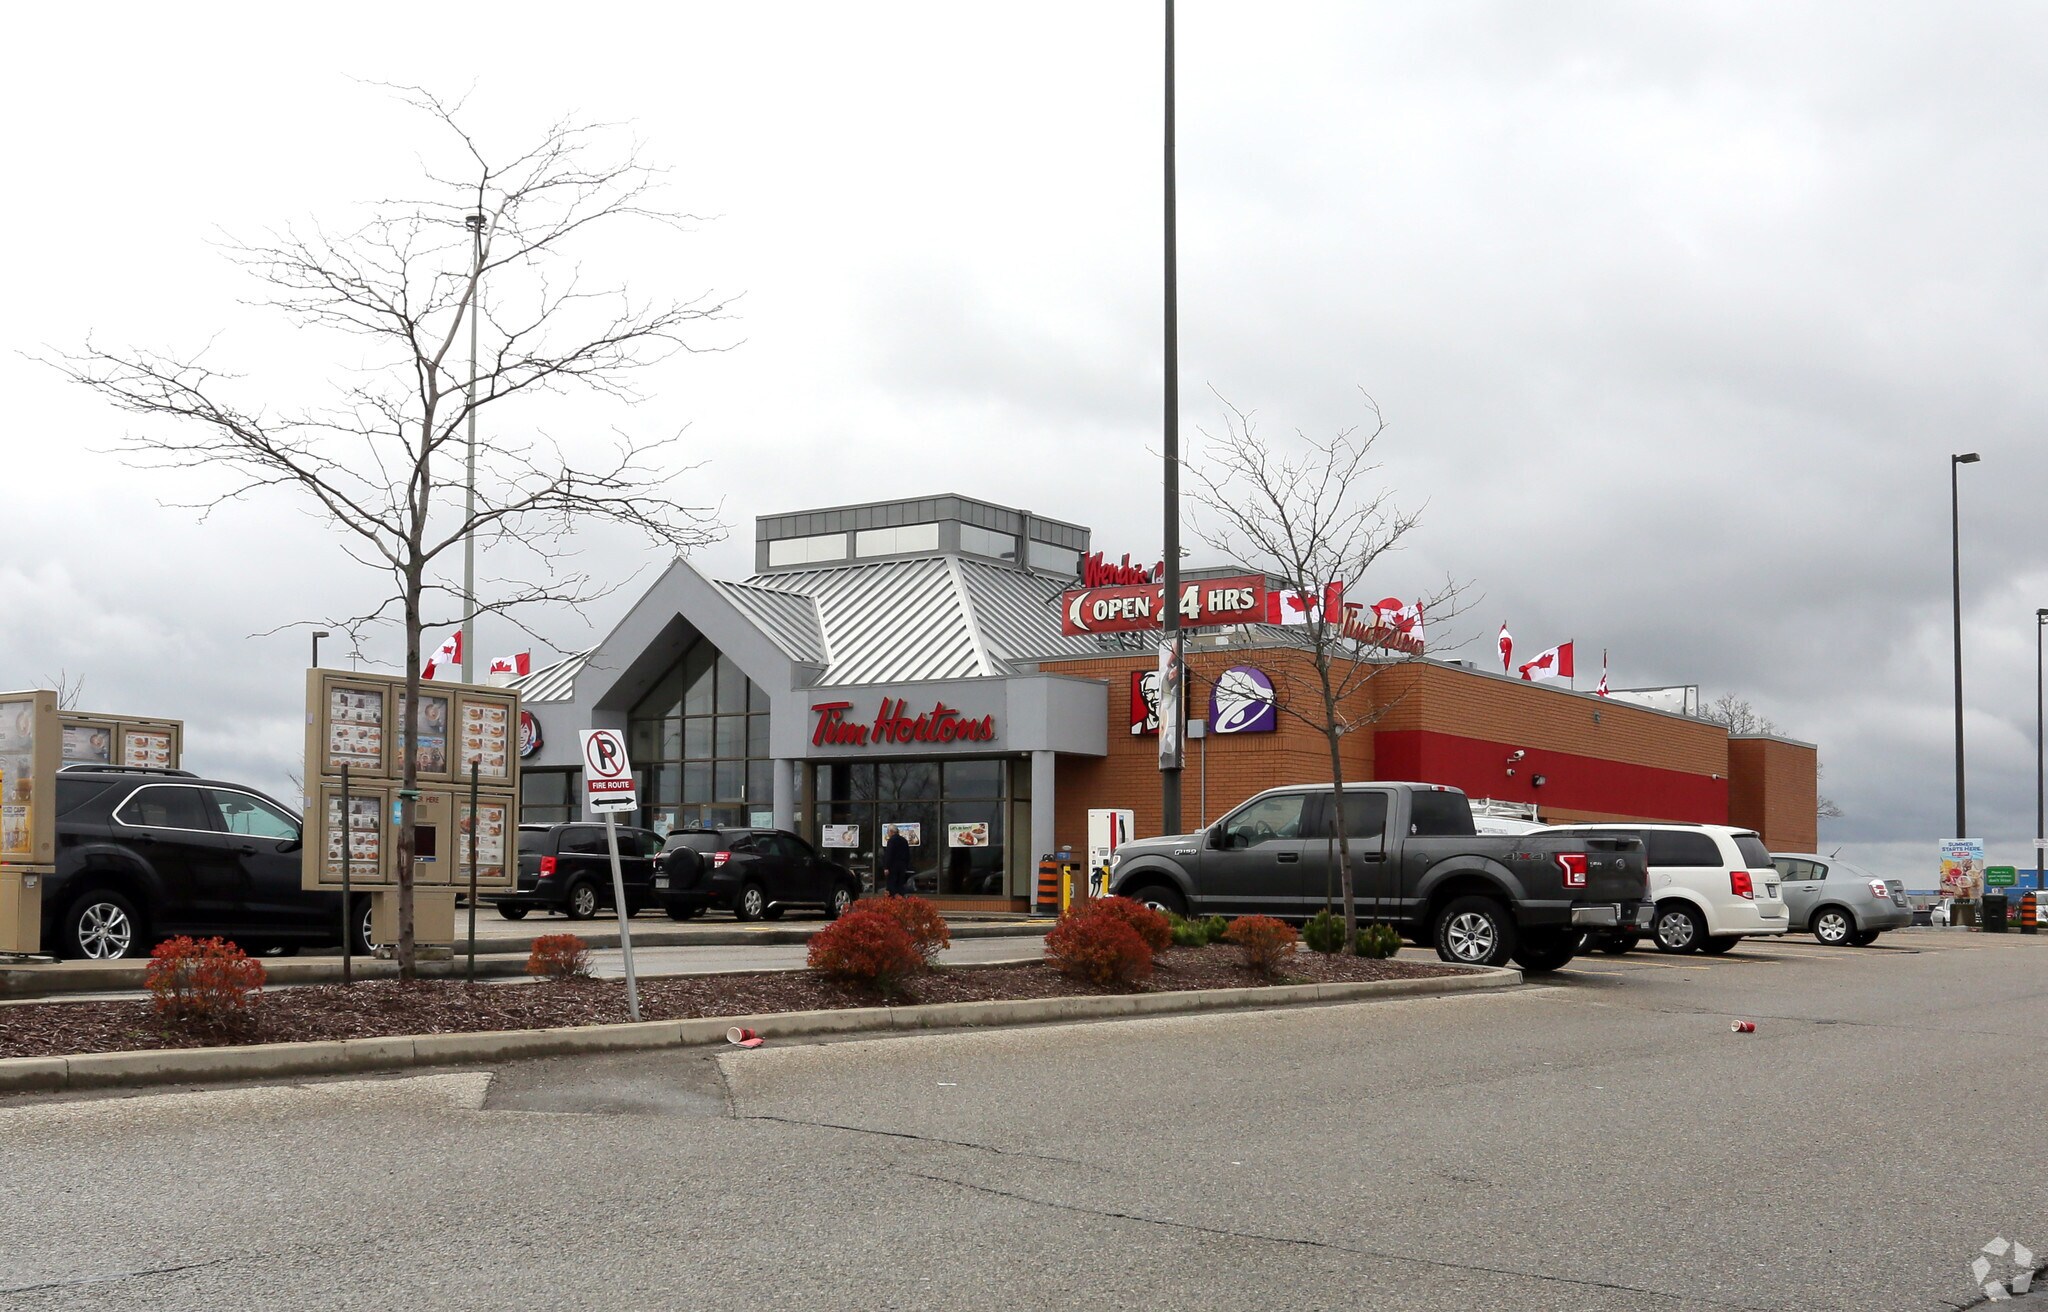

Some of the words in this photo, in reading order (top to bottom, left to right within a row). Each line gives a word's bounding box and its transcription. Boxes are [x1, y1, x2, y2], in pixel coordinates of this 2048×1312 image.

[1084, 550, 1148, 588] Wendy's
[1092, 596, 1150, 621] OPEN
[1207, 587, 1255, 612] HRS
[811, 701, 869, 747] Tim
[871, 696, 996, 744] Hortons
[425, 796, 440, 804] HERE
[592, 782, 607, 790] FIRE
[607, 781, 630, 789] ROUTE
